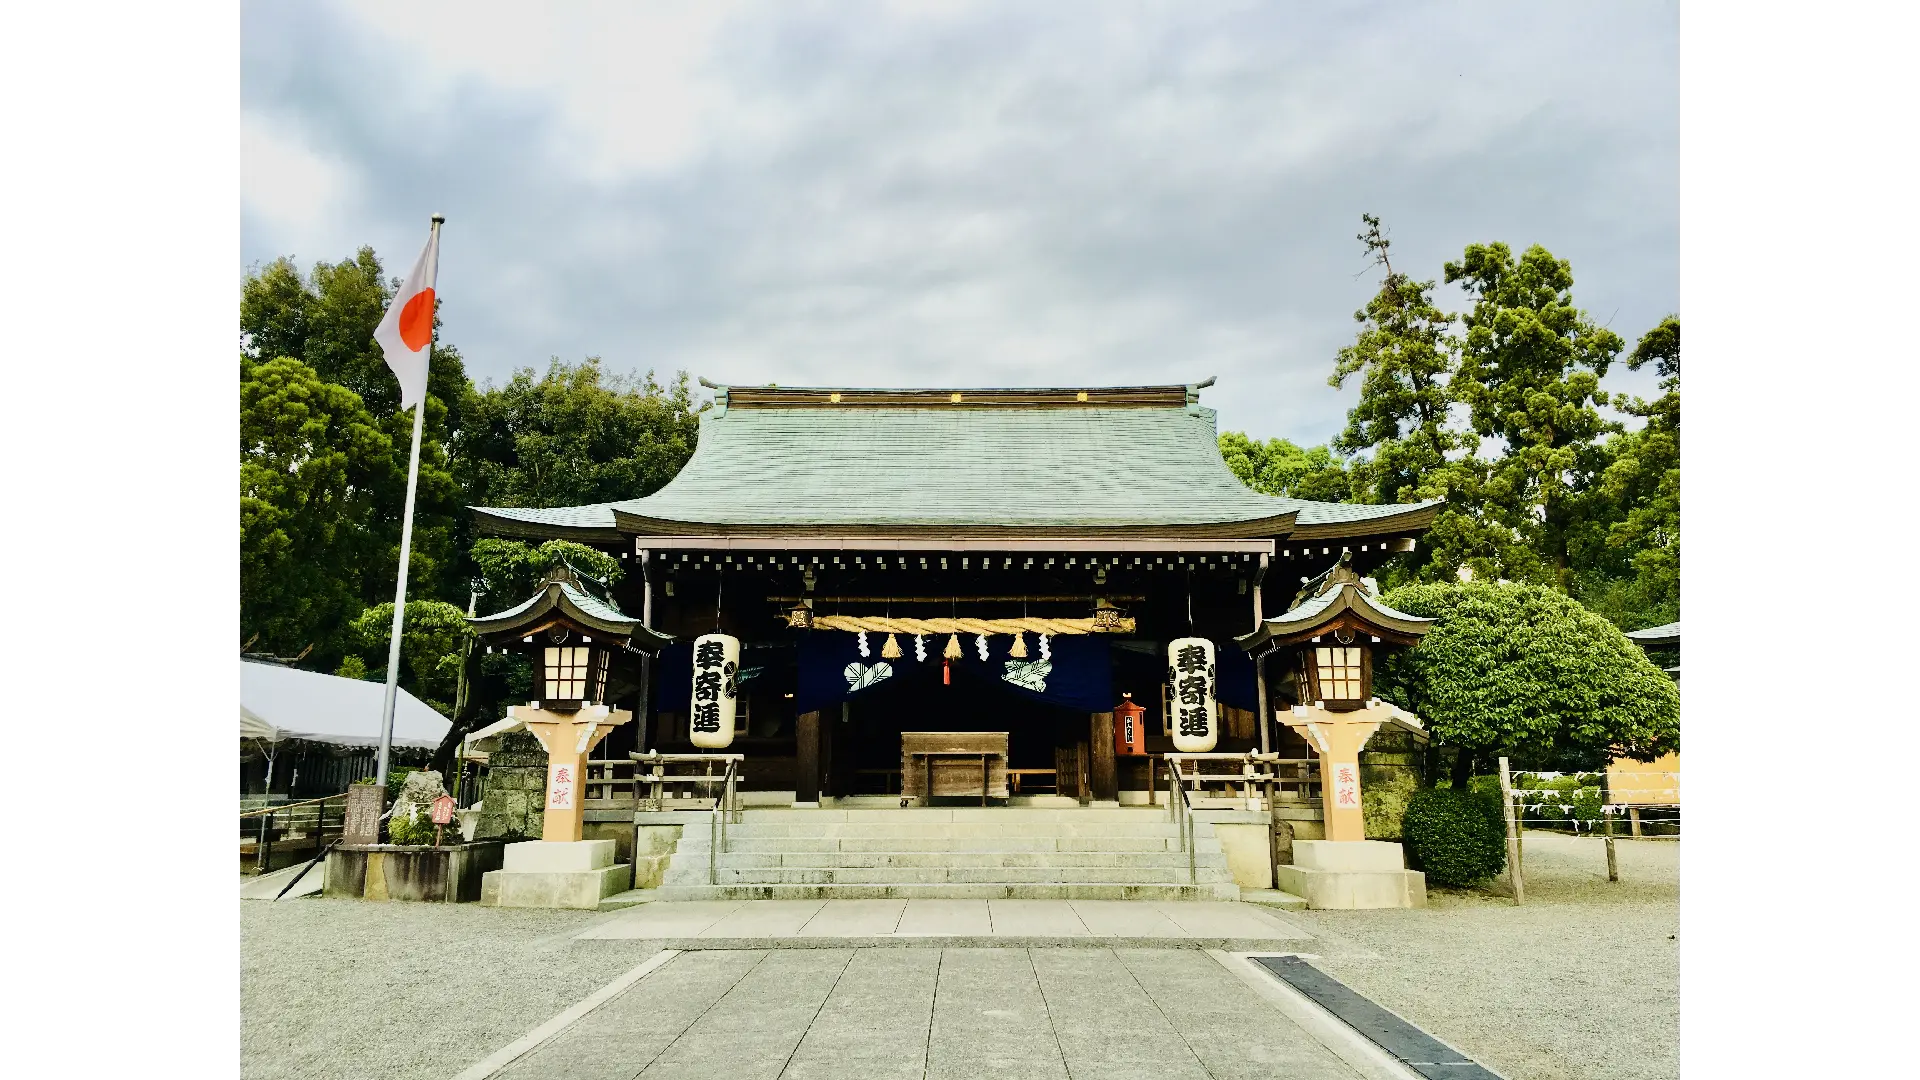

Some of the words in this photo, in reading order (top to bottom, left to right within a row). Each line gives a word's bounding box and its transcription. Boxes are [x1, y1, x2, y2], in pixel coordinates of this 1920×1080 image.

[693, 640, 725, 733] 奉寄進
[1177, 644, 1209, 737] 奉寄進
